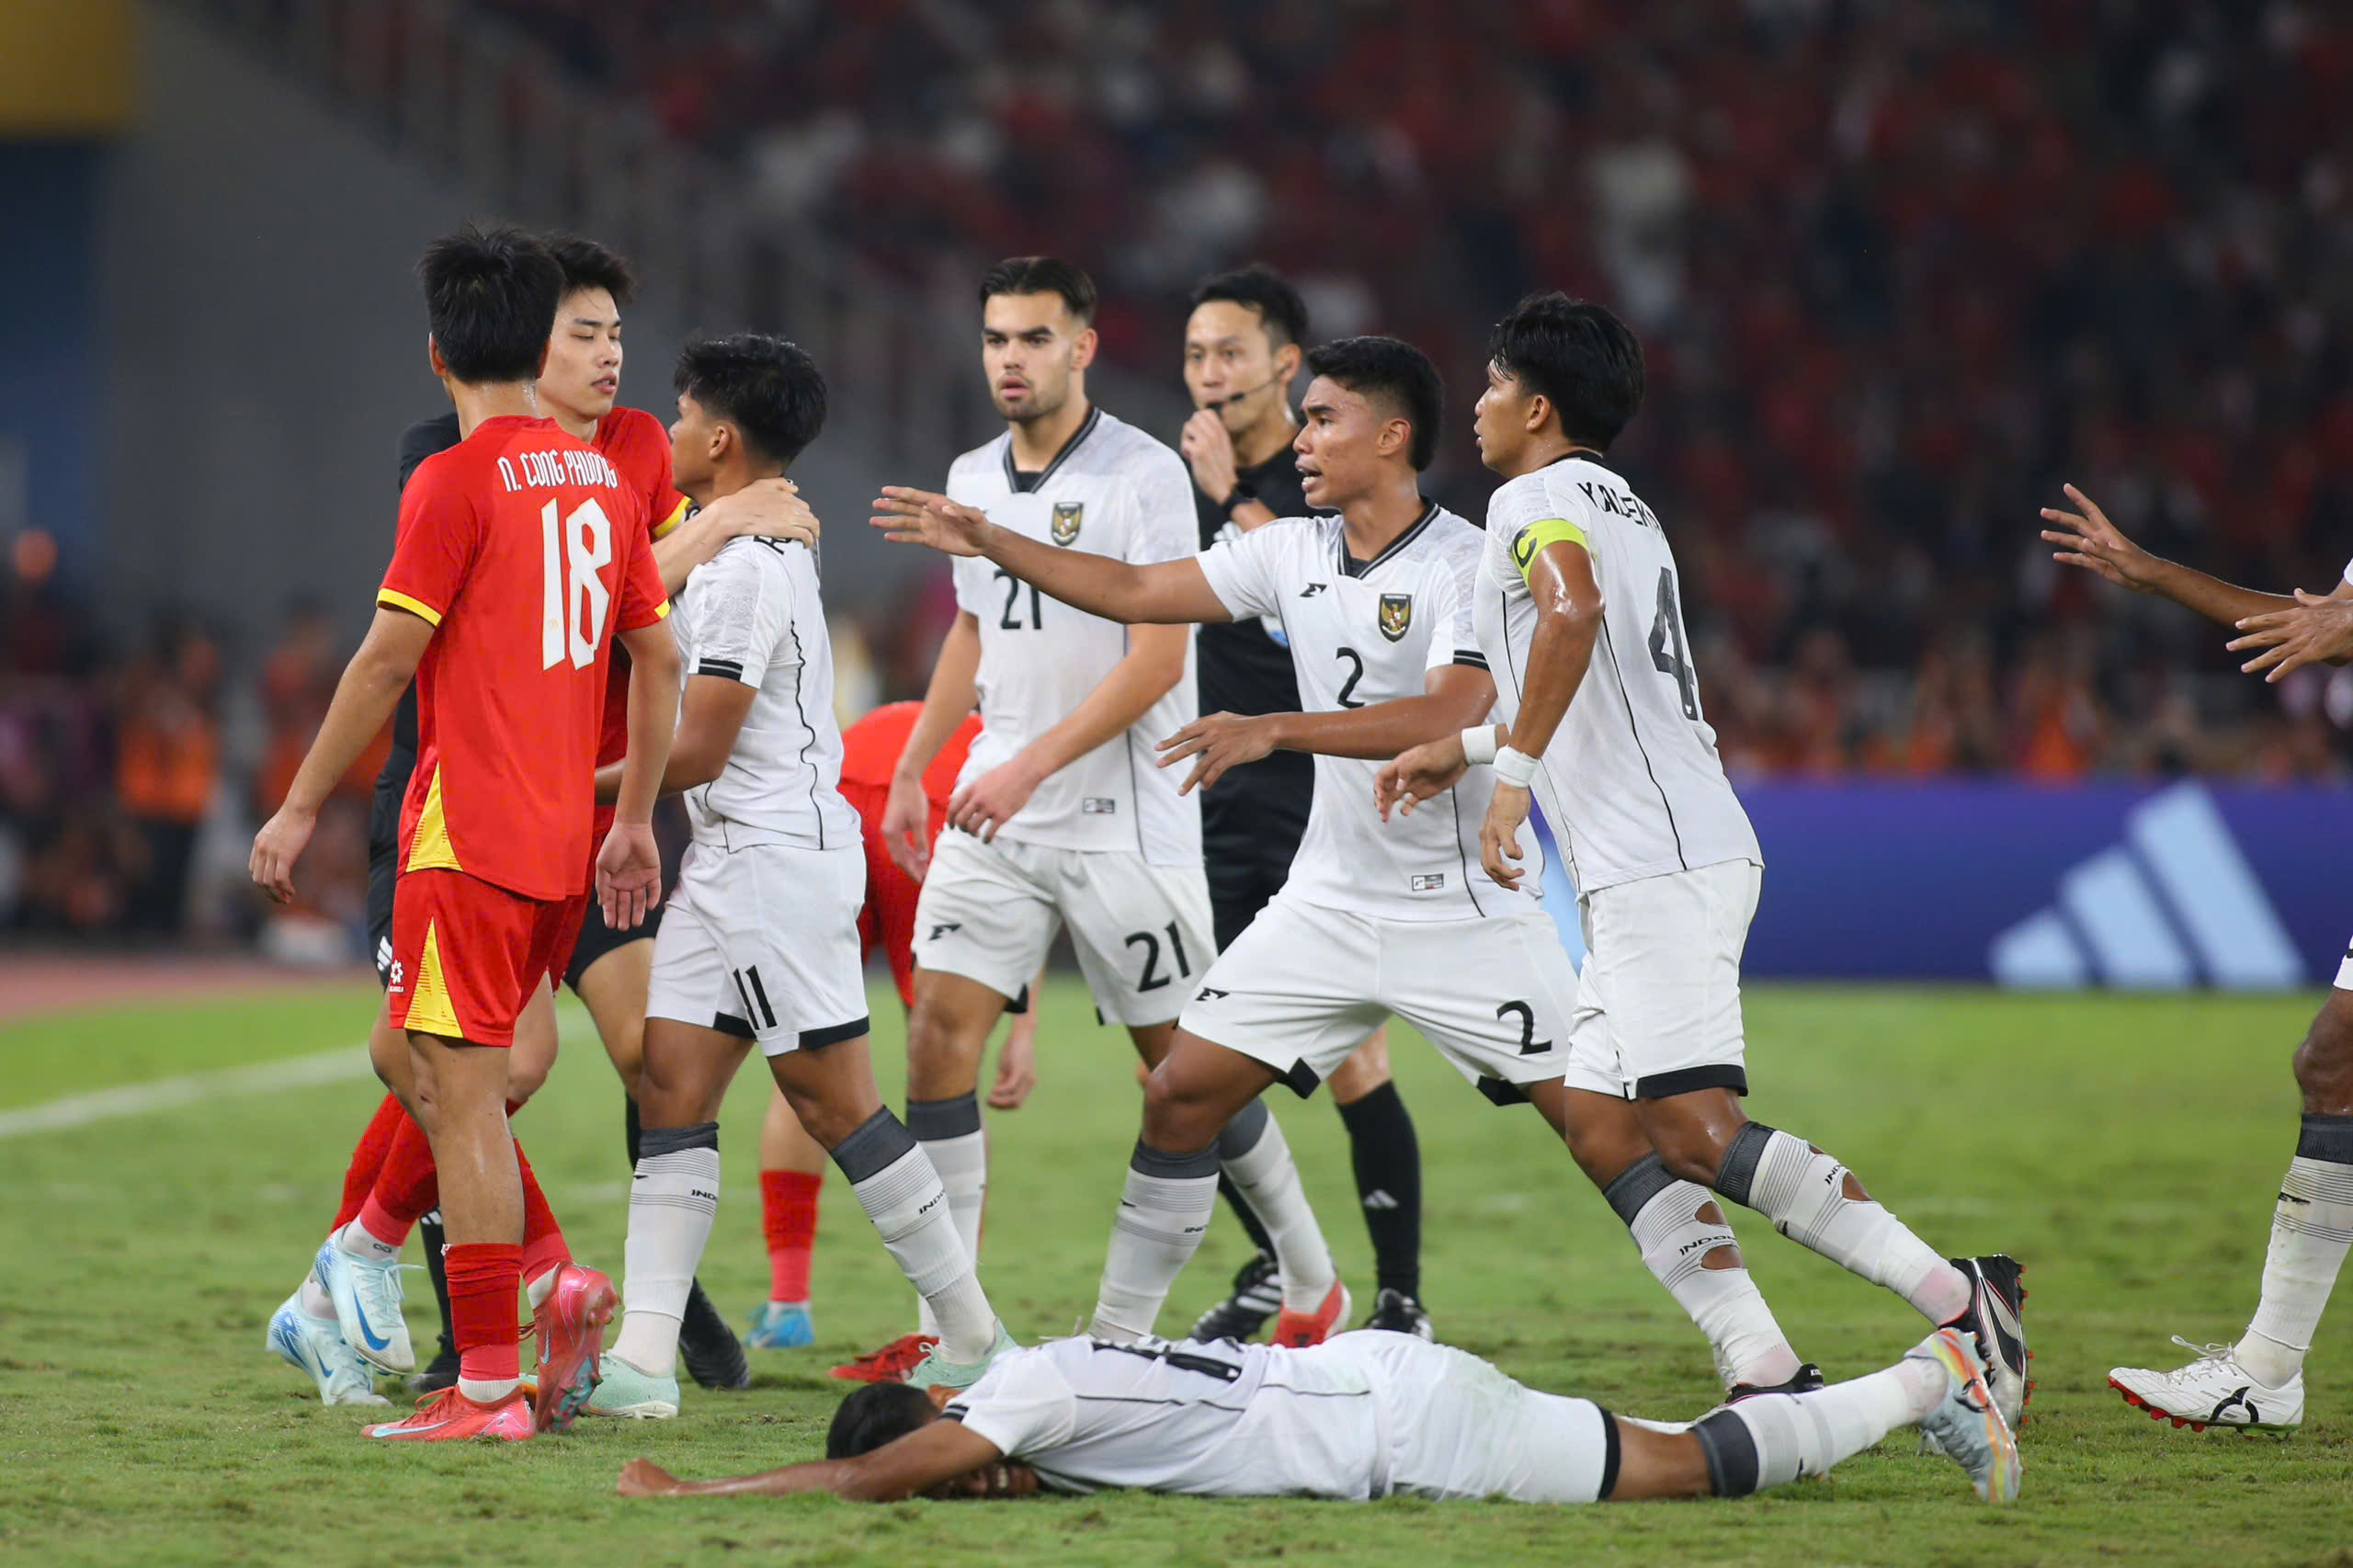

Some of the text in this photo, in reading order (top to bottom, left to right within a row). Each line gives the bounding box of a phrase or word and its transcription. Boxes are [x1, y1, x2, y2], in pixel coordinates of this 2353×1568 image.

[497, 449, 618, 492] N. CONG PHUONG
[540, 496, 612, 671] 18
[994, 569, 1041, 630] 21
[1648, 566, 1699, 721] 4
[1336, 647, 1365, 709] 2
[1124, 920, 1191, 993] 21
[733, 965, 778, 1030] 11
[1496, 1000, 1552, 1055] 2
